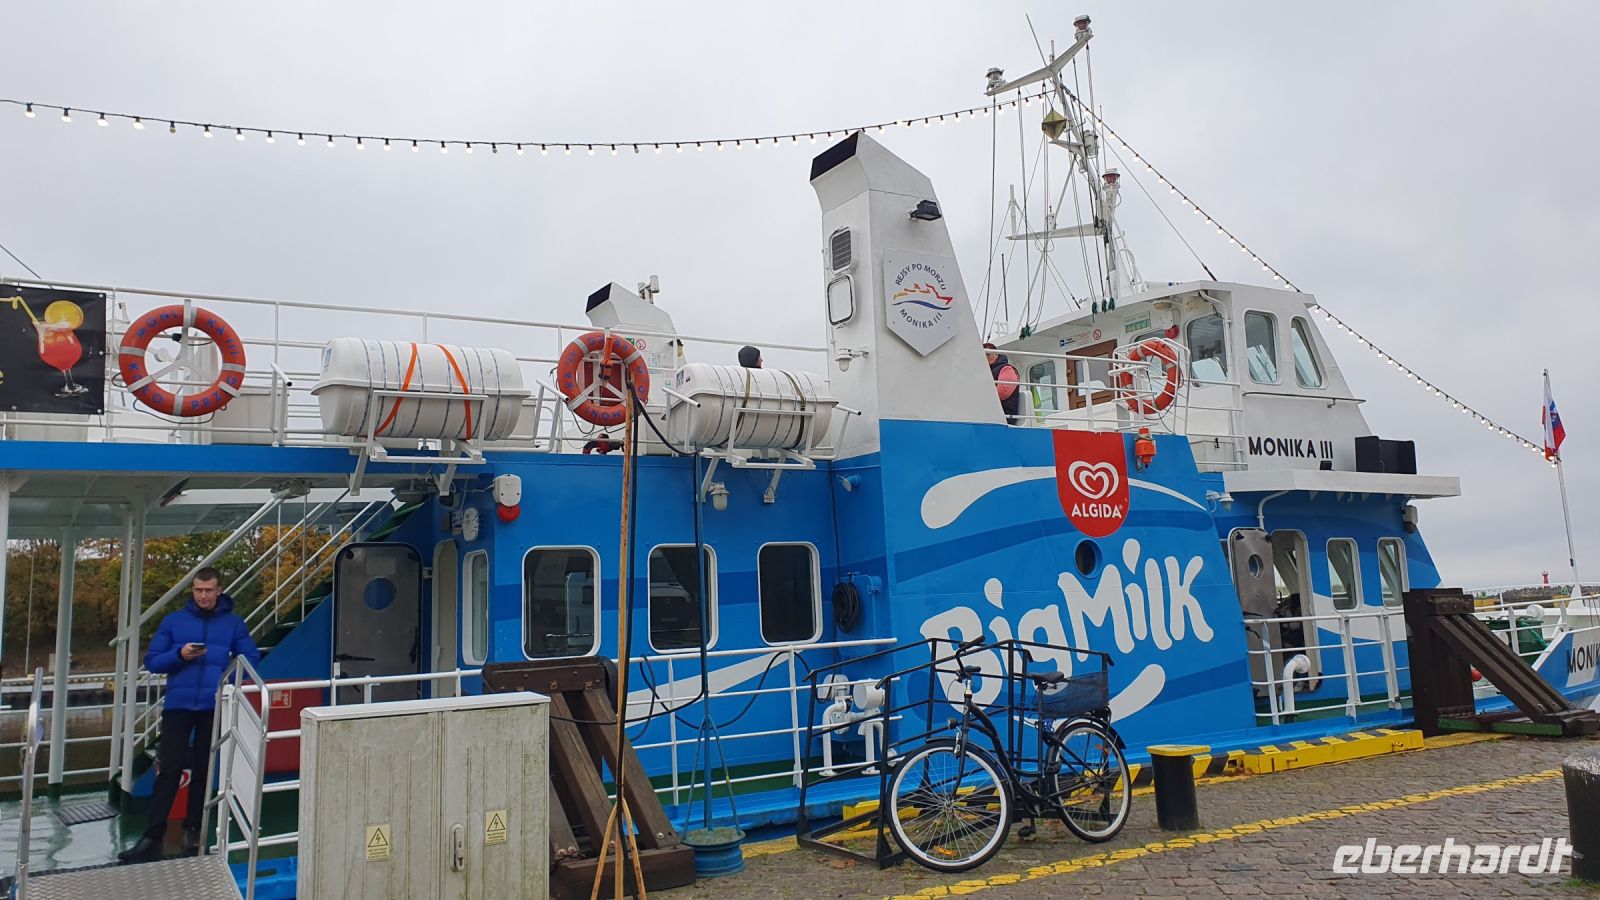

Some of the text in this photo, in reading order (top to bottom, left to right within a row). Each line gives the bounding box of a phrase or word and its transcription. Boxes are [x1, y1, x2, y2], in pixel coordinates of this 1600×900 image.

[895, 263, 947, 290] REJSY PO MORZU
[899, 308, 943, 329] MONIKA III
[1248, 436, 1333, 459] MONIKA III
[1071, 502, 1123, 519] ALGIDA
